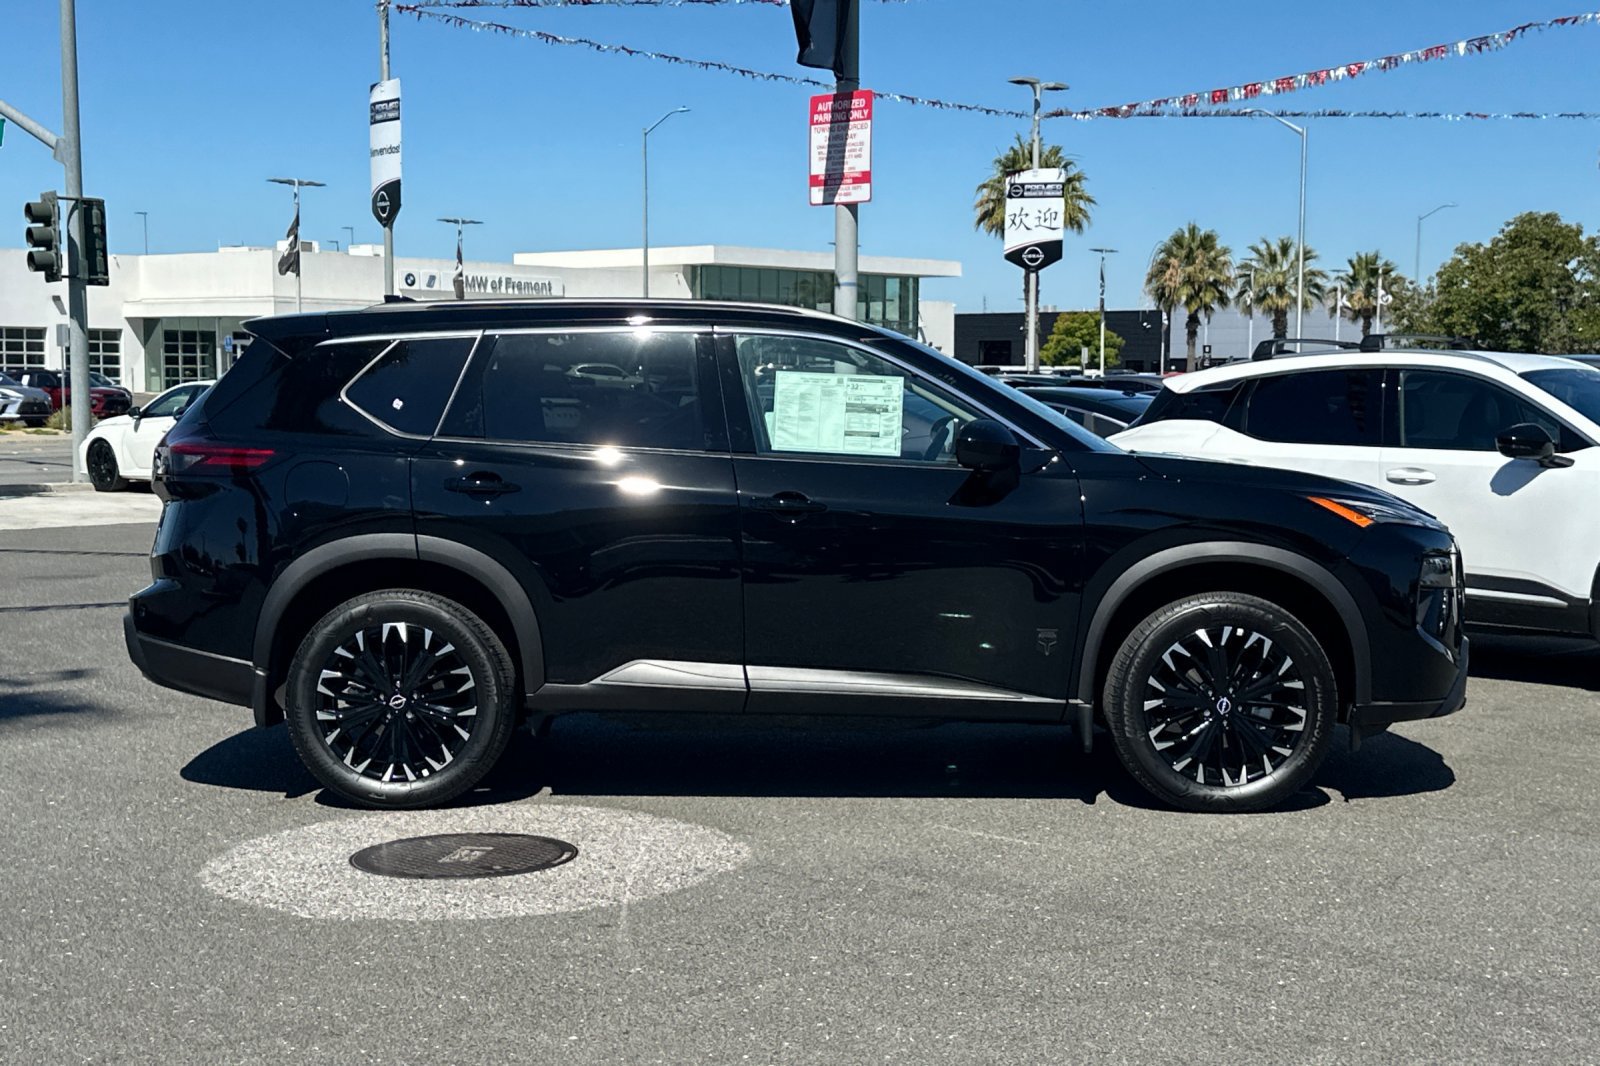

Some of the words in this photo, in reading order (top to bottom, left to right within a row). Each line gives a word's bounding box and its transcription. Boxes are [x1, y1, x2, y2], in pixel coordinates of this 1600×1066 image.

[816, 98, 866, 112] AUTHORIZED
[813, 111, 847, 123] PARKING
[849, 109, 869, 120] ONLY
[1008, 206, 1060, 230] 欢迎
[465, 275, 488, 293] MW
[490, 276, 502, 292] of
[505, 277, 552, 296] Fremont
